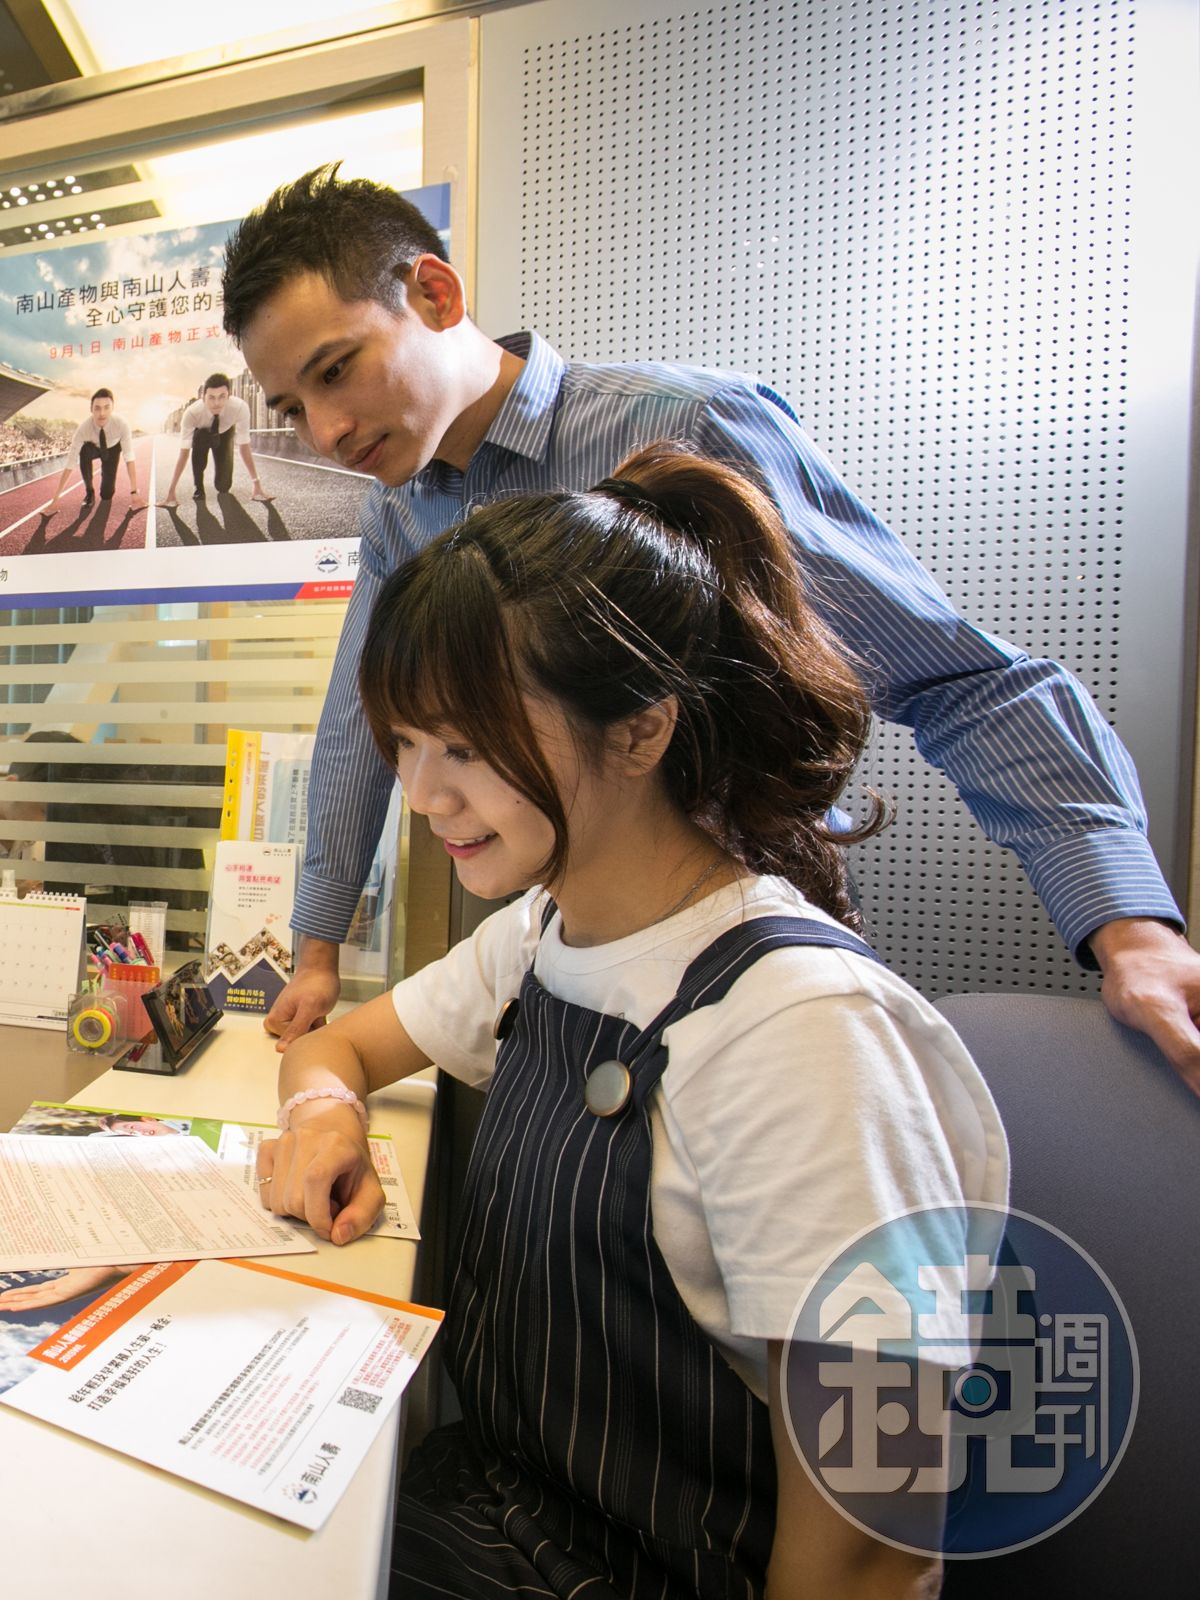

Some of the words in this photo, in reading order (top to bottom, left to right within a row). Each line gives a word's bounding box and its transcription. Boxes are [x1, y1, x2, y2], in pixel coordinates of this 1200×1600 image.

[16, 266, 209, 315] 南山產物與南山人壽
[50, 339, 102, 359] 9月1日
[300, 1442, 341, 1486] 南山人壽
